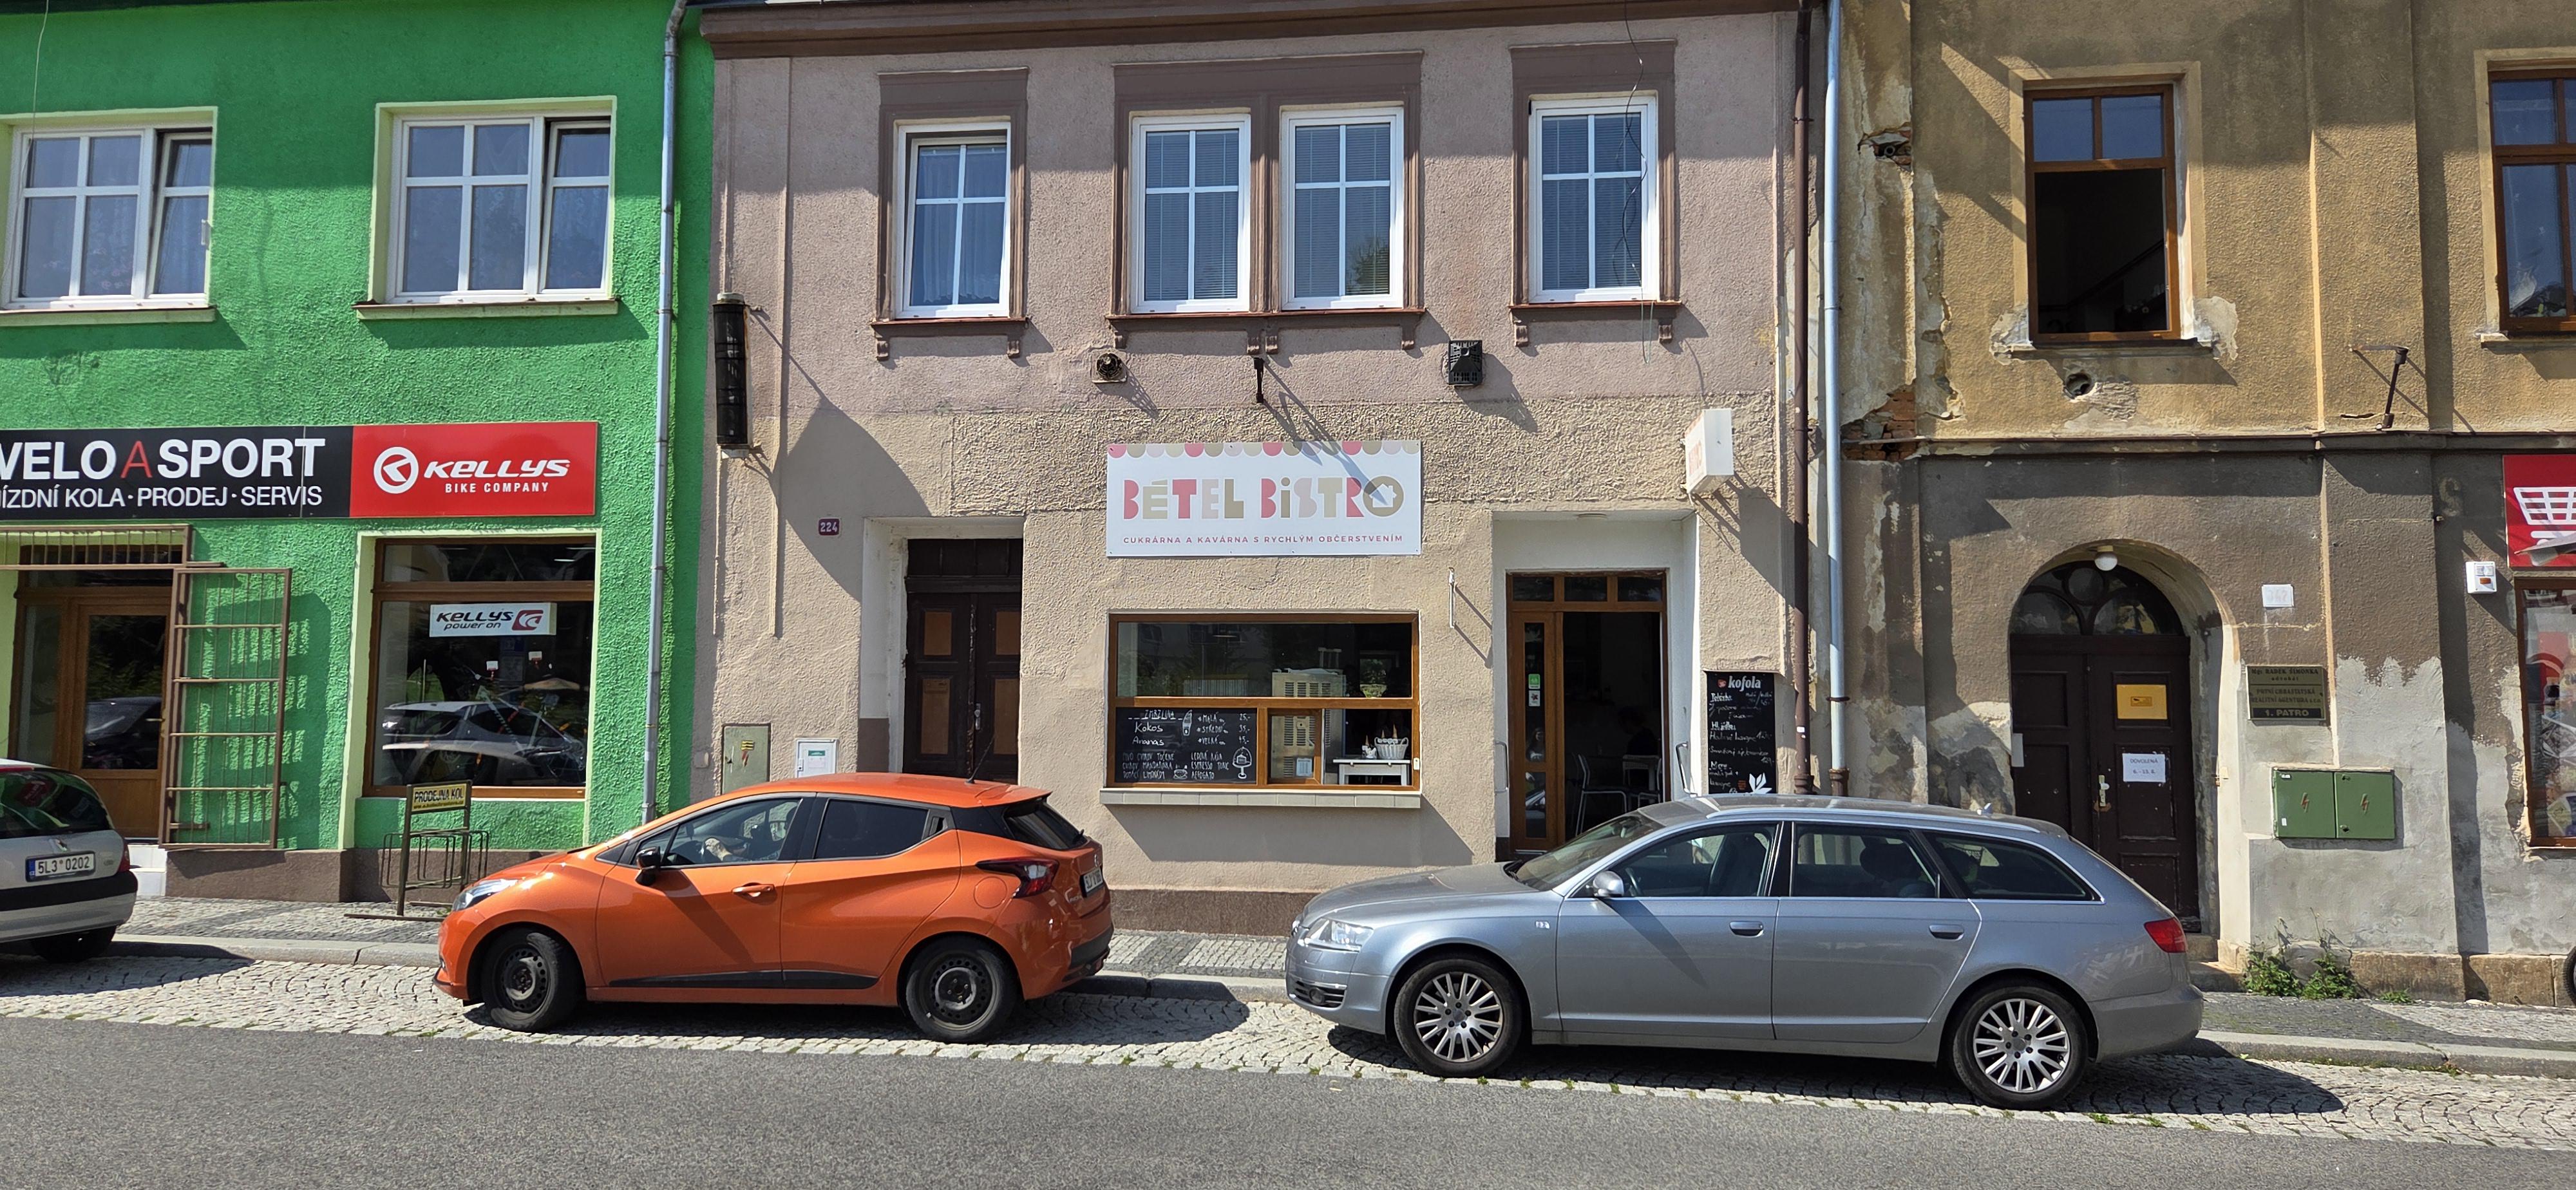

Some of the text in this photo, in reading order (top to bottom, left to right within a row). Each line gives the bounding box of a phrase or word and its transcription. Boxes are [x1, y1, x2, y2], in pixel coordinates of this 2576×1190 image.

[157, 438, 326, 478] SPORT
[445, 482, 549, 493] BIKE COMPANY
[0, 484, 61, 509] ÍZDNÍ
[1123, 478, 1244, 520] BÉTEL
[820, 522, 838, 533] 224
[1197, 535, 1249, 543] KAVÁRNA
[1264, 534, 1314, 543] RYCHLÝM
[1318, 534, 1403, 543] OBČERSTVENÍM
[444, 622, 484, 631] power
[1728, 675, 1761, 692] kofola
[1135, 721, 1164, 733] Kokos
[1132, 736, 1165, 746] Ananas
[414, 788, 463, 802] PRODEJNA KOL
[38, 860, 58, 874] 5L3
[66, 856, 90, 871] 0202
